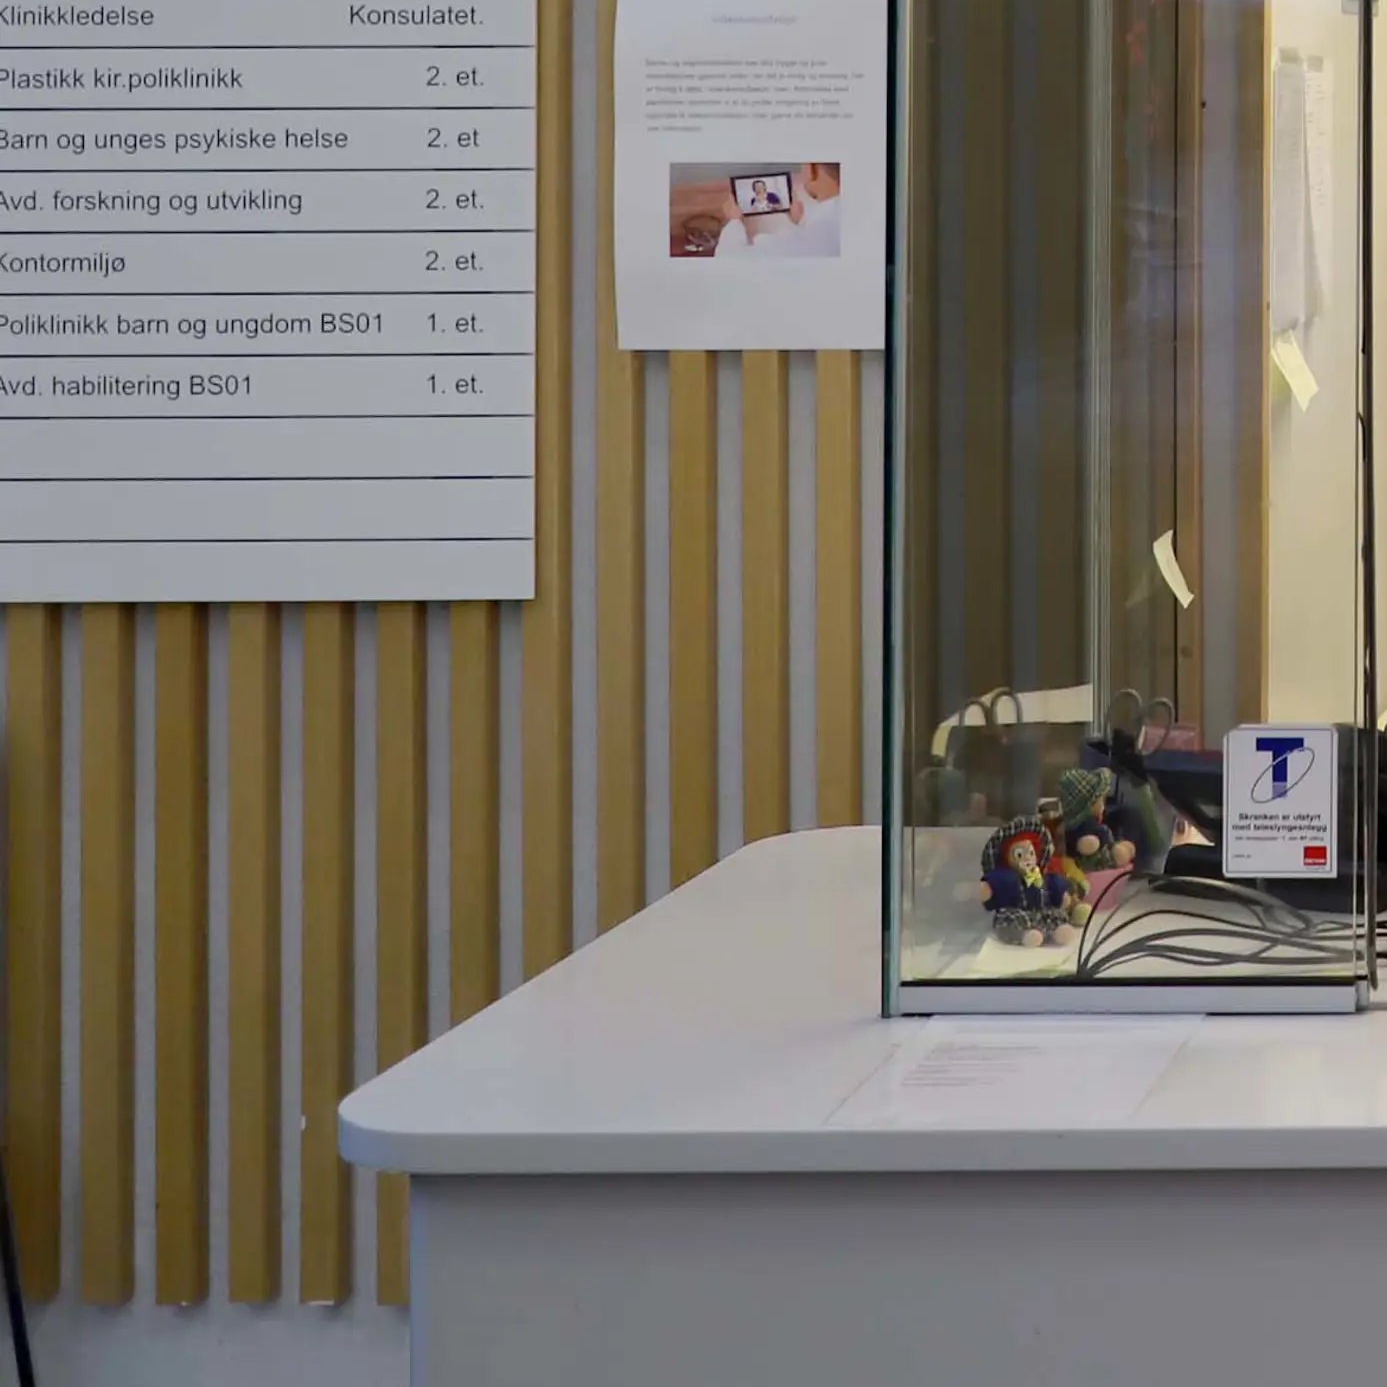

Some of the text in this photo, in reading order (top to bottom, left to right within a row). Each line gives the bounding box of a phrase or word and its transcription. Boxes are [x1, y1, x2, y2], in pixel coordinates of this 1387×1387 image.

[350, 4, 483, 25] Konsulatet.
[94, 67, 242, 93] kir.poliklinikk
[426, 66, 484, 86] 2. et.
[57, 134, 85, 155] og
[95, 133, 166, 154] unges
[175, 128, 276, 154] psykiske
[285, 128, 348, 148] helse
[428, 128, 479, 148] 2. et
[53, 190, 160, 216] forskning
[169, 195, 197, 216] og
[207, 189, 302, 215] utvikling
[426, 188, 484, 209] 2. et.
[425, 250, 483, 271] 2. et.
[117, 314, 169, 335] barn
[178, 319, 206, 339] og
[216, 313, 311, 339] ungdom
[321, 312, 381, 333] BS01
[428, 313, 483, 333] 1. et.
[53, 375, 180, 400] habilitering
[190, 374, 250, 396] BS01
[427, 374, 483, 394] 1. et.
[1232, 823, 1251, 831] med
